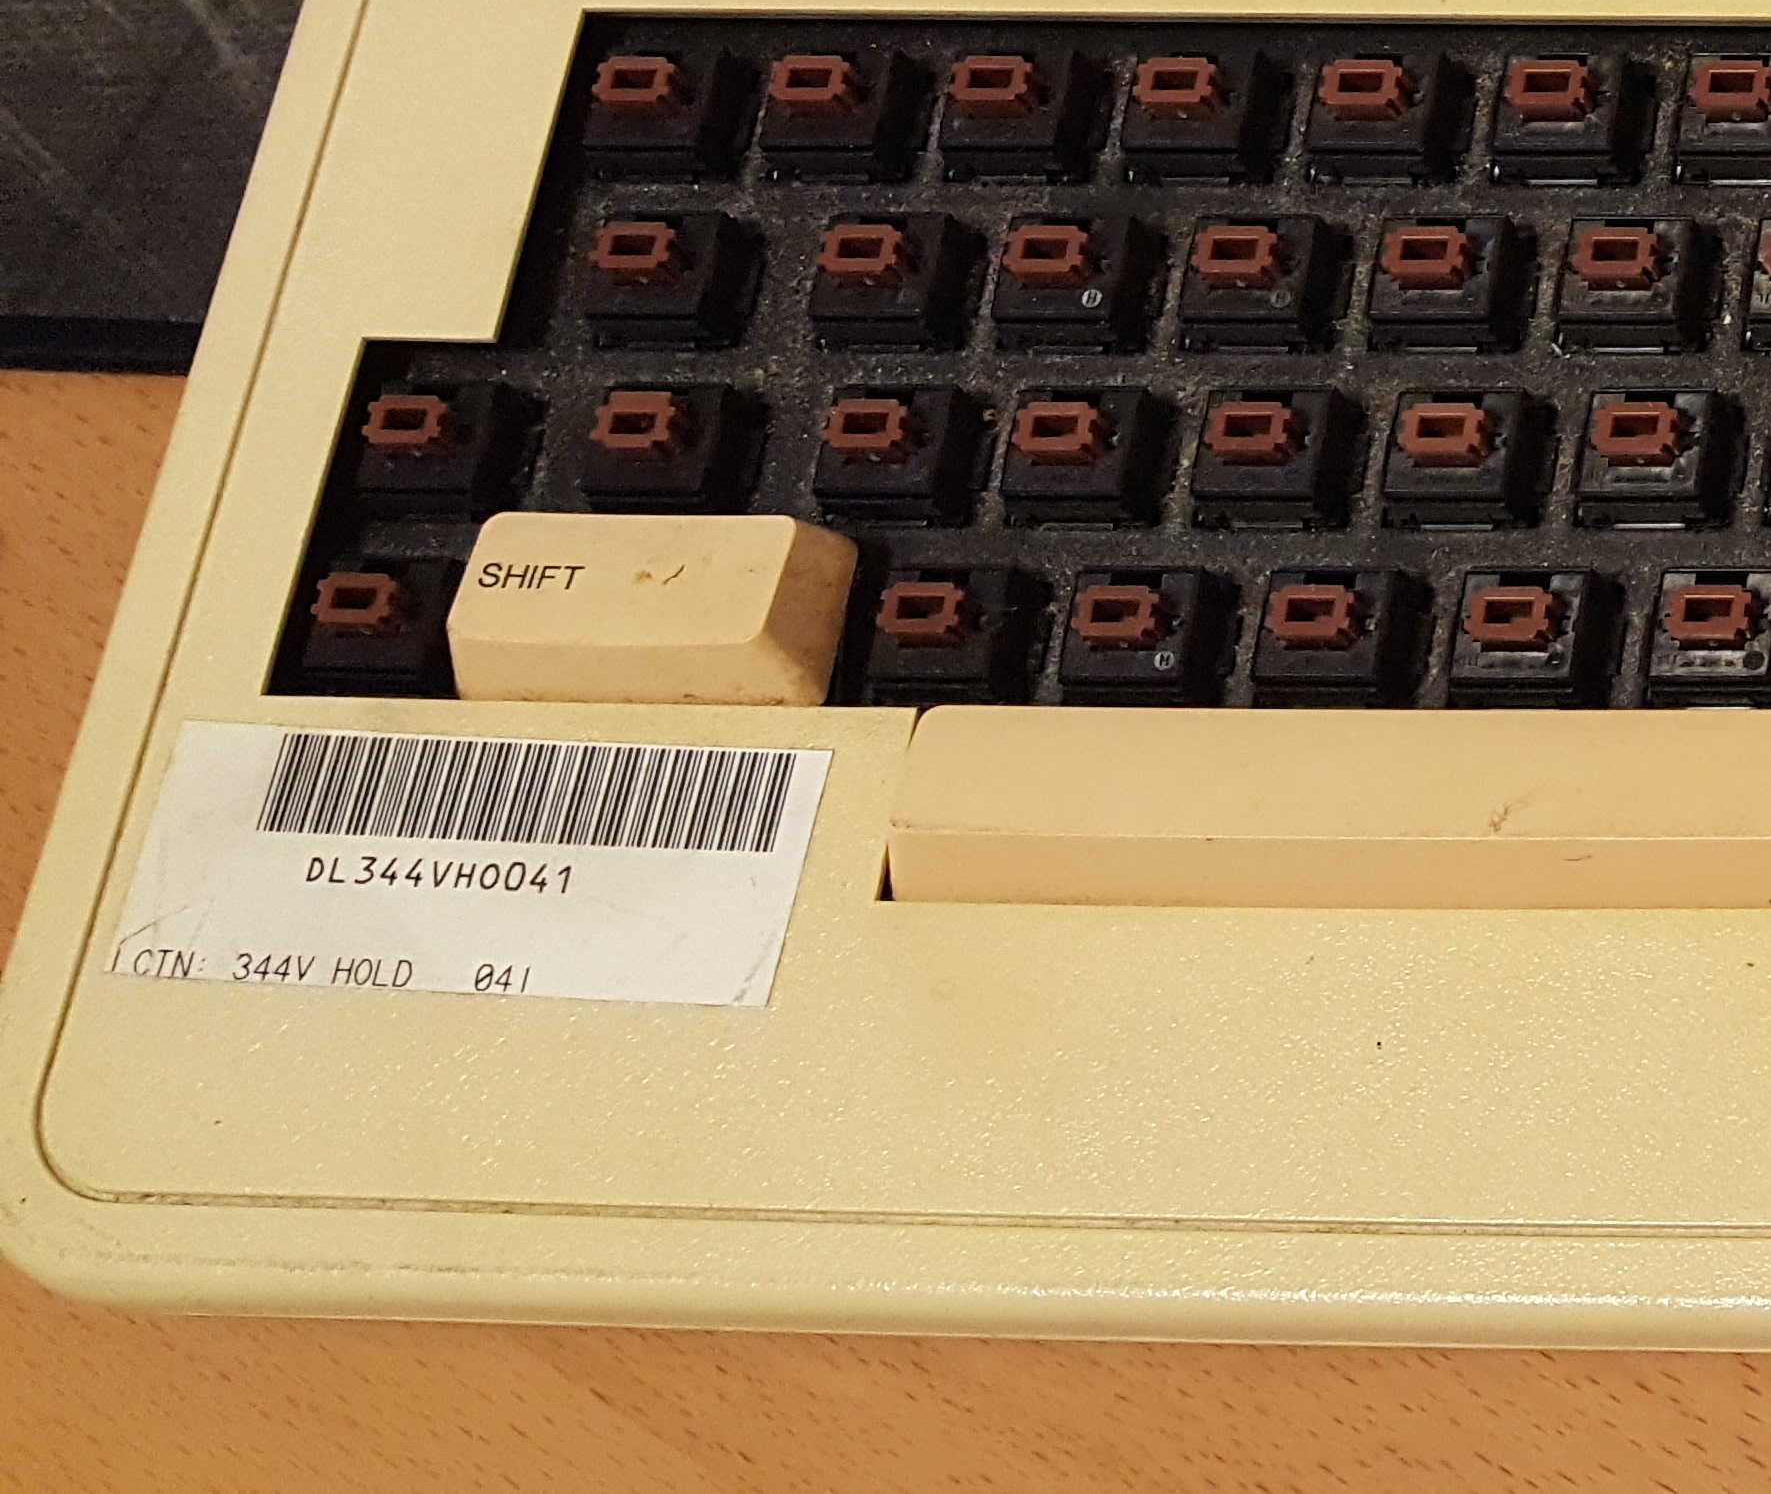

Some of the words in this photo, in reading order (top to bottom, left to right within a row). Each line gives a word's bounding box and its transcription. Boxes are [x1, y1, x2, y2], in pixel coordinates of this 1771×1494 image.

[478, 562, 584, 591] SHIFT
[232, 953, 314, 980] 344V
[331, 957, 413, 988] HOLD
[474, 963, 530, 992] 041
